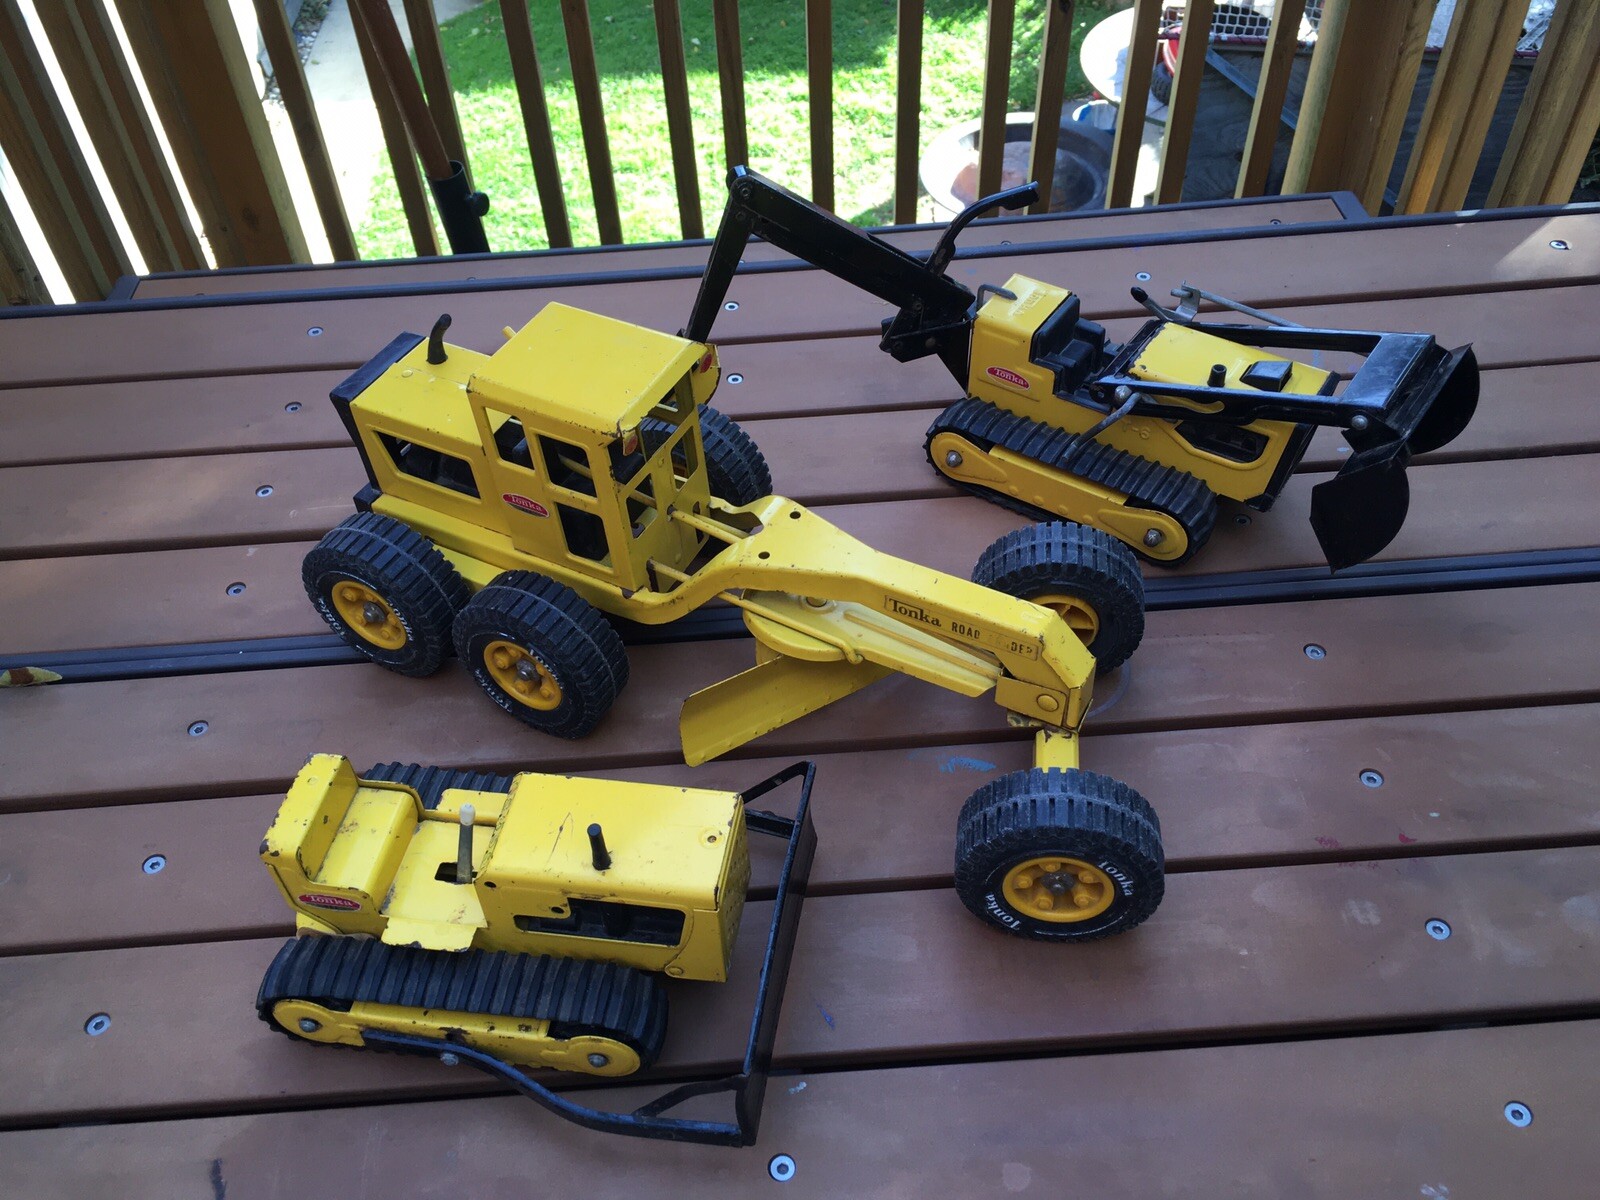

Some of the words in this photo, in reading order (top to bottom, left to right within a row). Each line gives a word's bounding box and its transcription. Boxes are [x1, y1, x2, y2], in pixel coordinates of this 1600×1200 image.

[994, 368, 1026, 386] Tonka
[510, 495, 543, 512] Tonka
[889, 598, 942, 628] Tonka
[951, 621, 981, 639] ROAD
[1098, 860, 1136, 897] Tonka
[306, 894, 353, 907] Tonka
[985, 893, 1021, 931] Tonka
